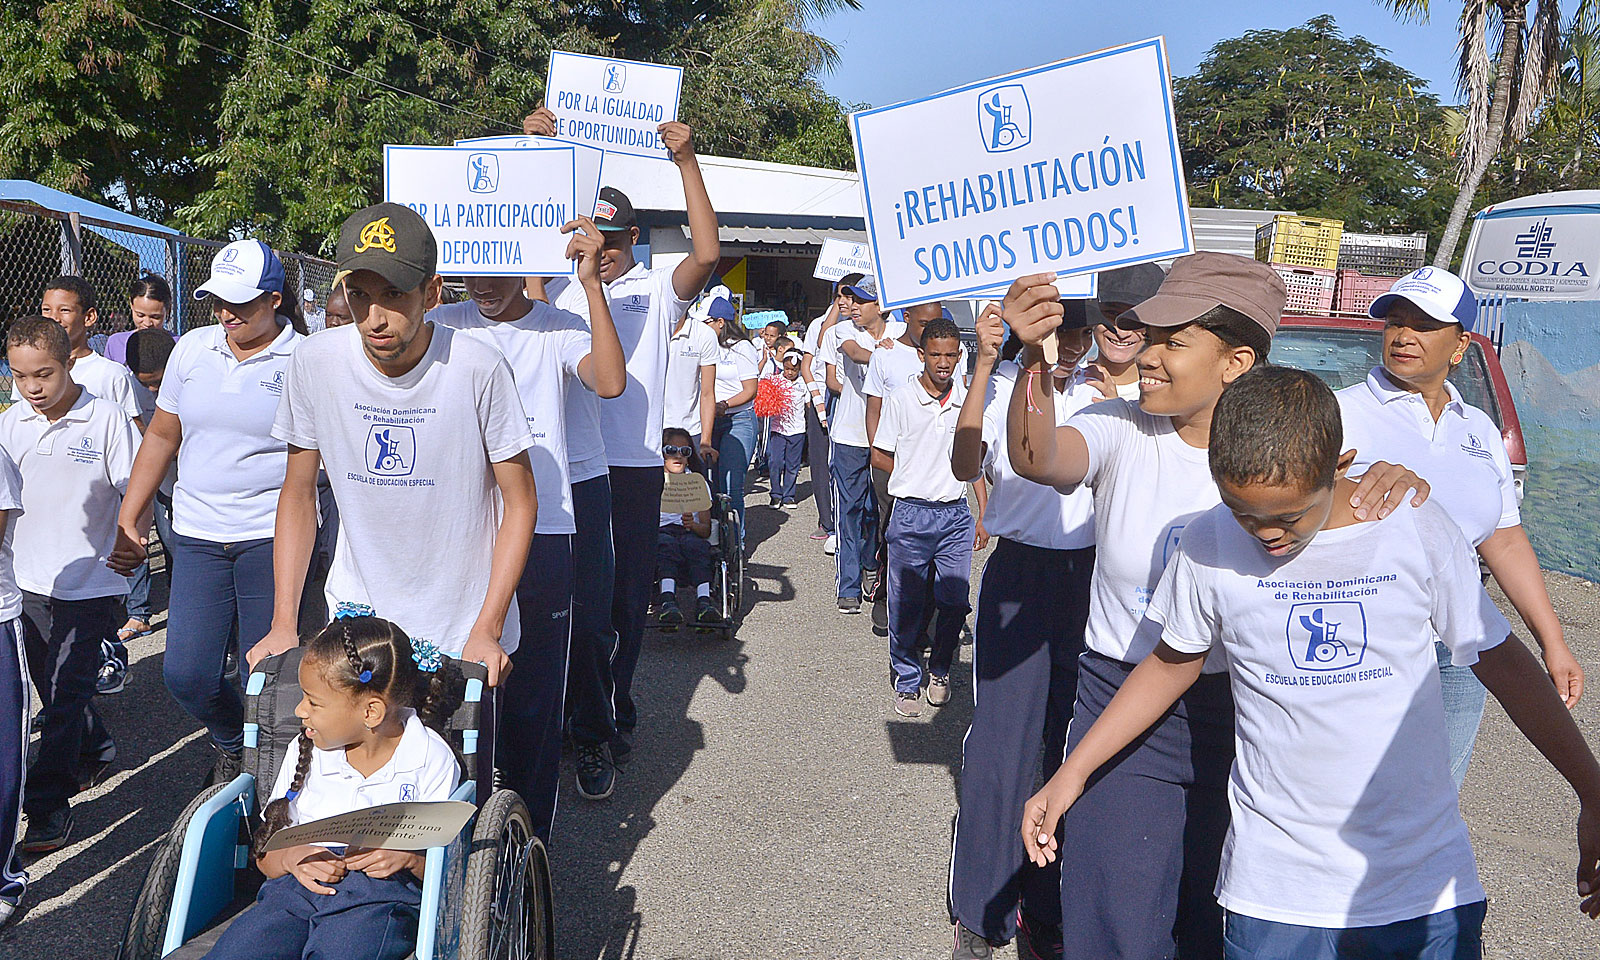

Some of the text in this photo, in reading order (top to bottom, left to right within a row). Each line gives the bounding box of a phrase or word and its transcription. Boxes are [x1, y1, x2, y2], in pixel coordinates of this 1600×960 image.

[557, 91, 664, 122] POR LA IGUALDAD
[894, 135, 1147, 240] ¡REHABILITACIÓN
[434, 203, 451, 227] LA
[457, 196, 566, 228] PARTICIPACIÓN
[442, 240, 523, 265] DEPORTIVA
[913, 205, 1139, 286] SOMOS TODOS!
[838, 256, 871, 270] HACIA UNA
[1477, 260, 1591, 278] CODIA
[1495, 284, 1529, 292] REGIONAL
[354, 403, 437, 415] Asociación Dominicana
[362, 413, 425, 425] de Rehabilitación
[347, 472, 369, 485] ESCUELA
[376, 478, 408, 487] EDUCACIÓN
[408, 479, 436, 487] ESPECIAL
[1257, 573, 1398, 590] Asociación Dominicana
[1274, 587, 1378, 601] de Rehabilitación
[1265, 666, 1393, 687] ESCUELA DE EDUCACIÓN ESPECIAL
